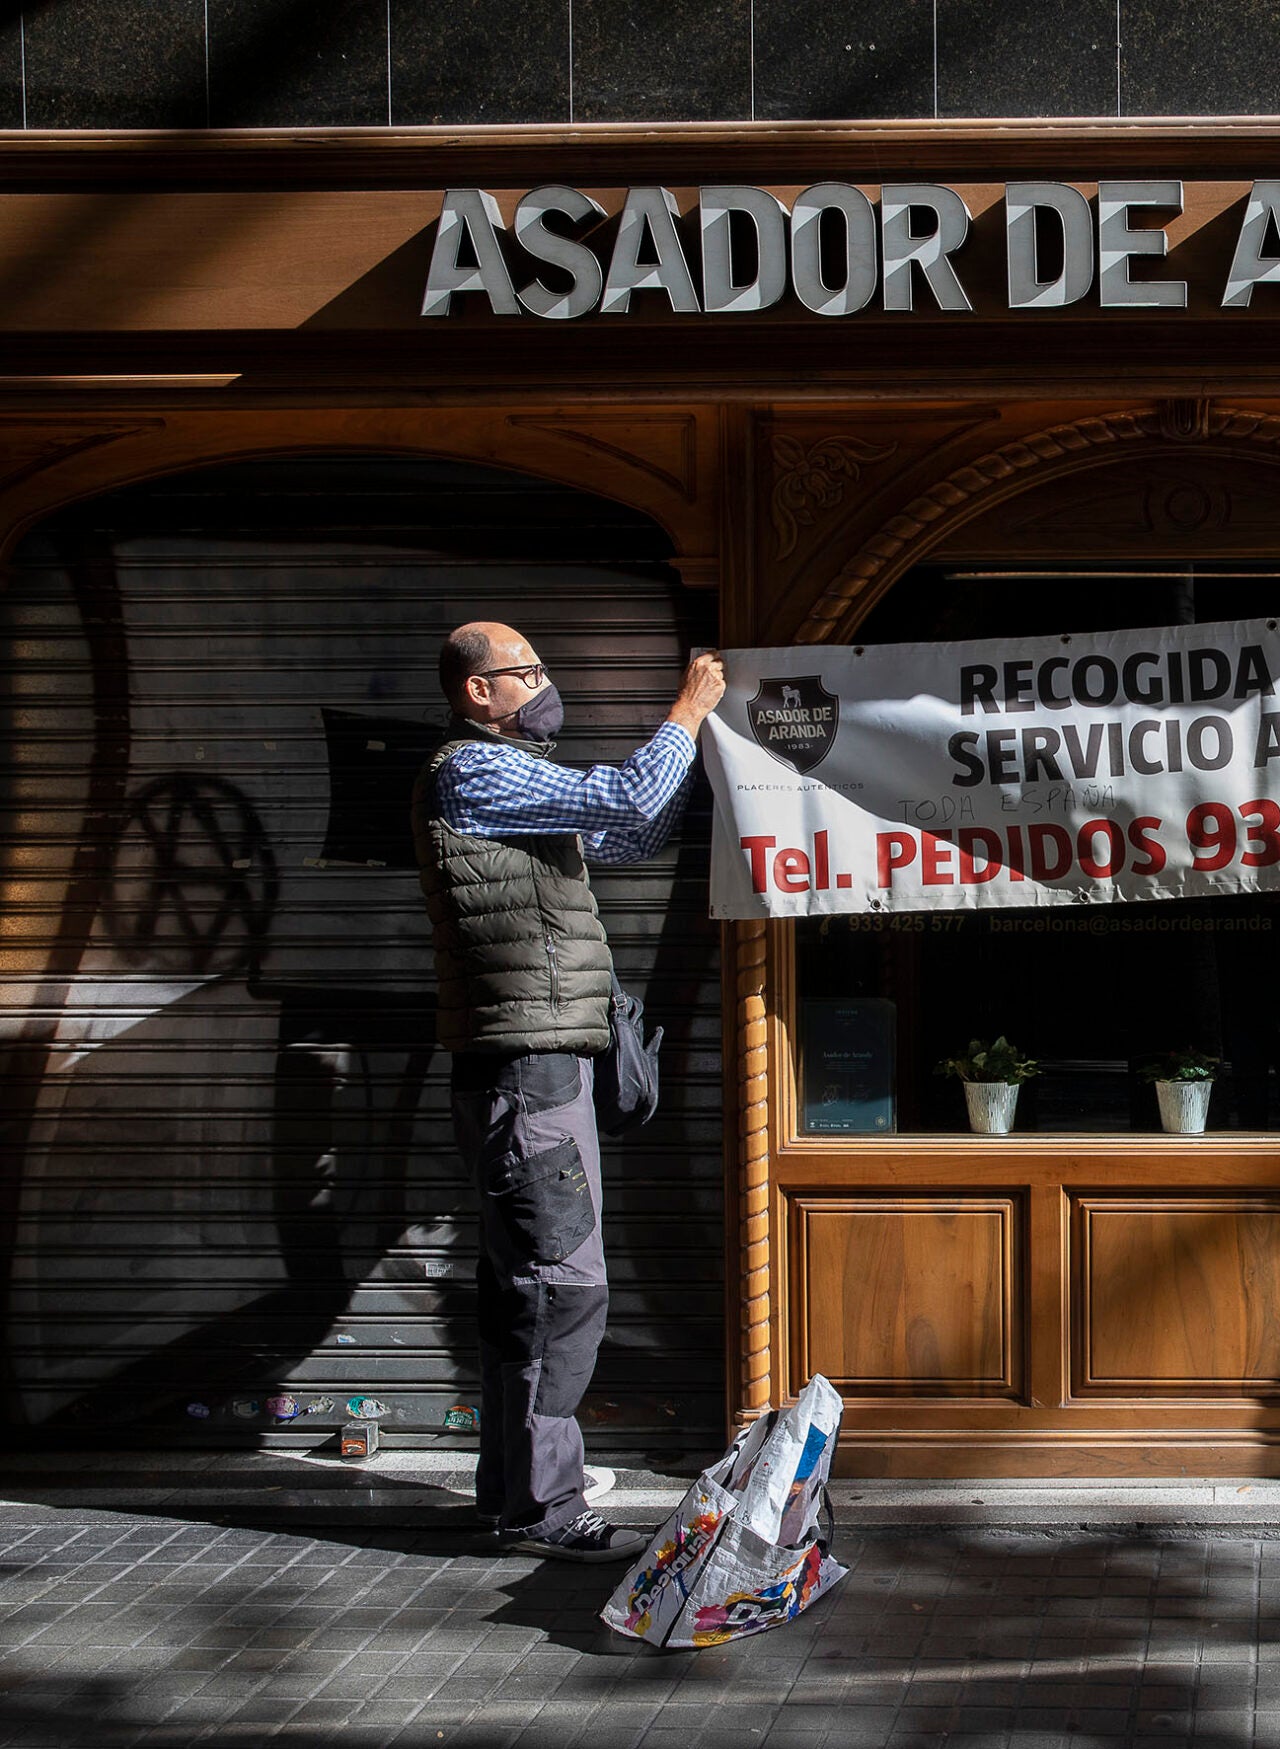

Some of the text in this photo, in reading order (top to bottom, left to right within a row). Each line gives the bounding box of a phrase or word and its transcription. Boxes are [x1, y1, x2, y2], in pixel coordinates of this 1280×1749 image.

[420, 181, 973, 320] ASADOR
[1005, 180, 1188, 309] DE
[960, 644, 1276, 716] RECOGIDA
[757, 707, 832, 724] ASADOR DE
[768, 724, 826, 740] ARANDA
[948, 714, 1233, 787] SERVICIO
[737, 784, 793, 792] PLACERES
[898, 784, 1116, 823] TODA ESPAÑA
[741, 829, 853, 894] Tel.
[876, 816, 1167, 888] PEDIDOS
[848, 915, 884, 932] 933
[889, 915, 925, 932] 425
[930, 914, 966, 931] 577
